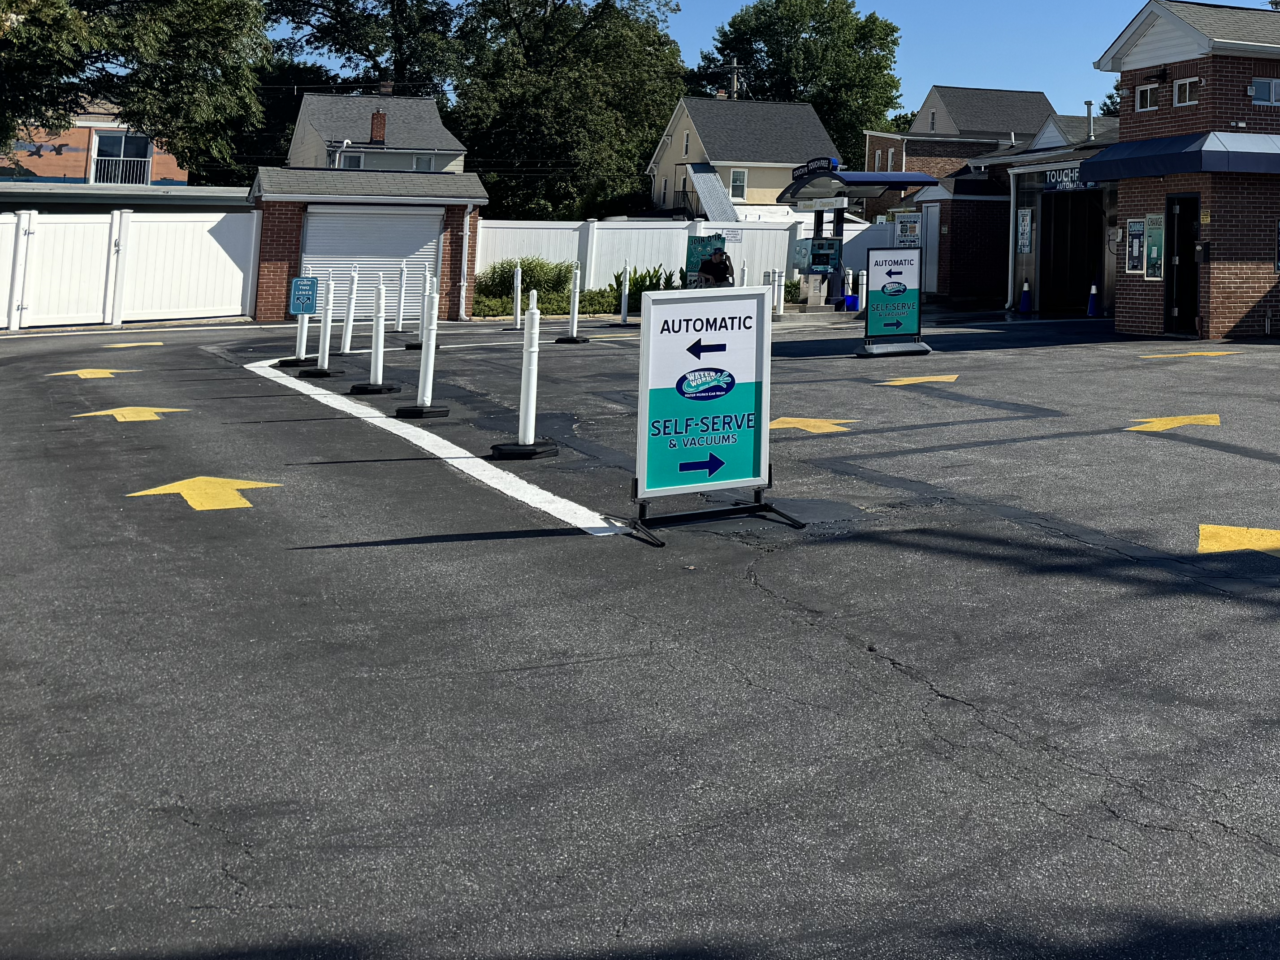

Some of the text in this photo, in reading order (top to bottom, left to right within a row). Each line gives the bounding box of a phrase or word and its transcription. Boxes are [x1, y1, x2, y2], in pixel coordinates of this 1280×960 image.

[1045, 168, 1080, 183] TOUCHF
[690, 236, 705, 246] JOIN
[873, 258, 915, 267] AUTOMATIC
[871, 302, 916, 312] SELF-SERVE
[660, 315, 753, 334] AUTOMATIC
[685, 371, 716, 382] WATER
[650, 412, 756, 437] SELF-SERVE
[668, 434, 738, 449] & VACUUMS
